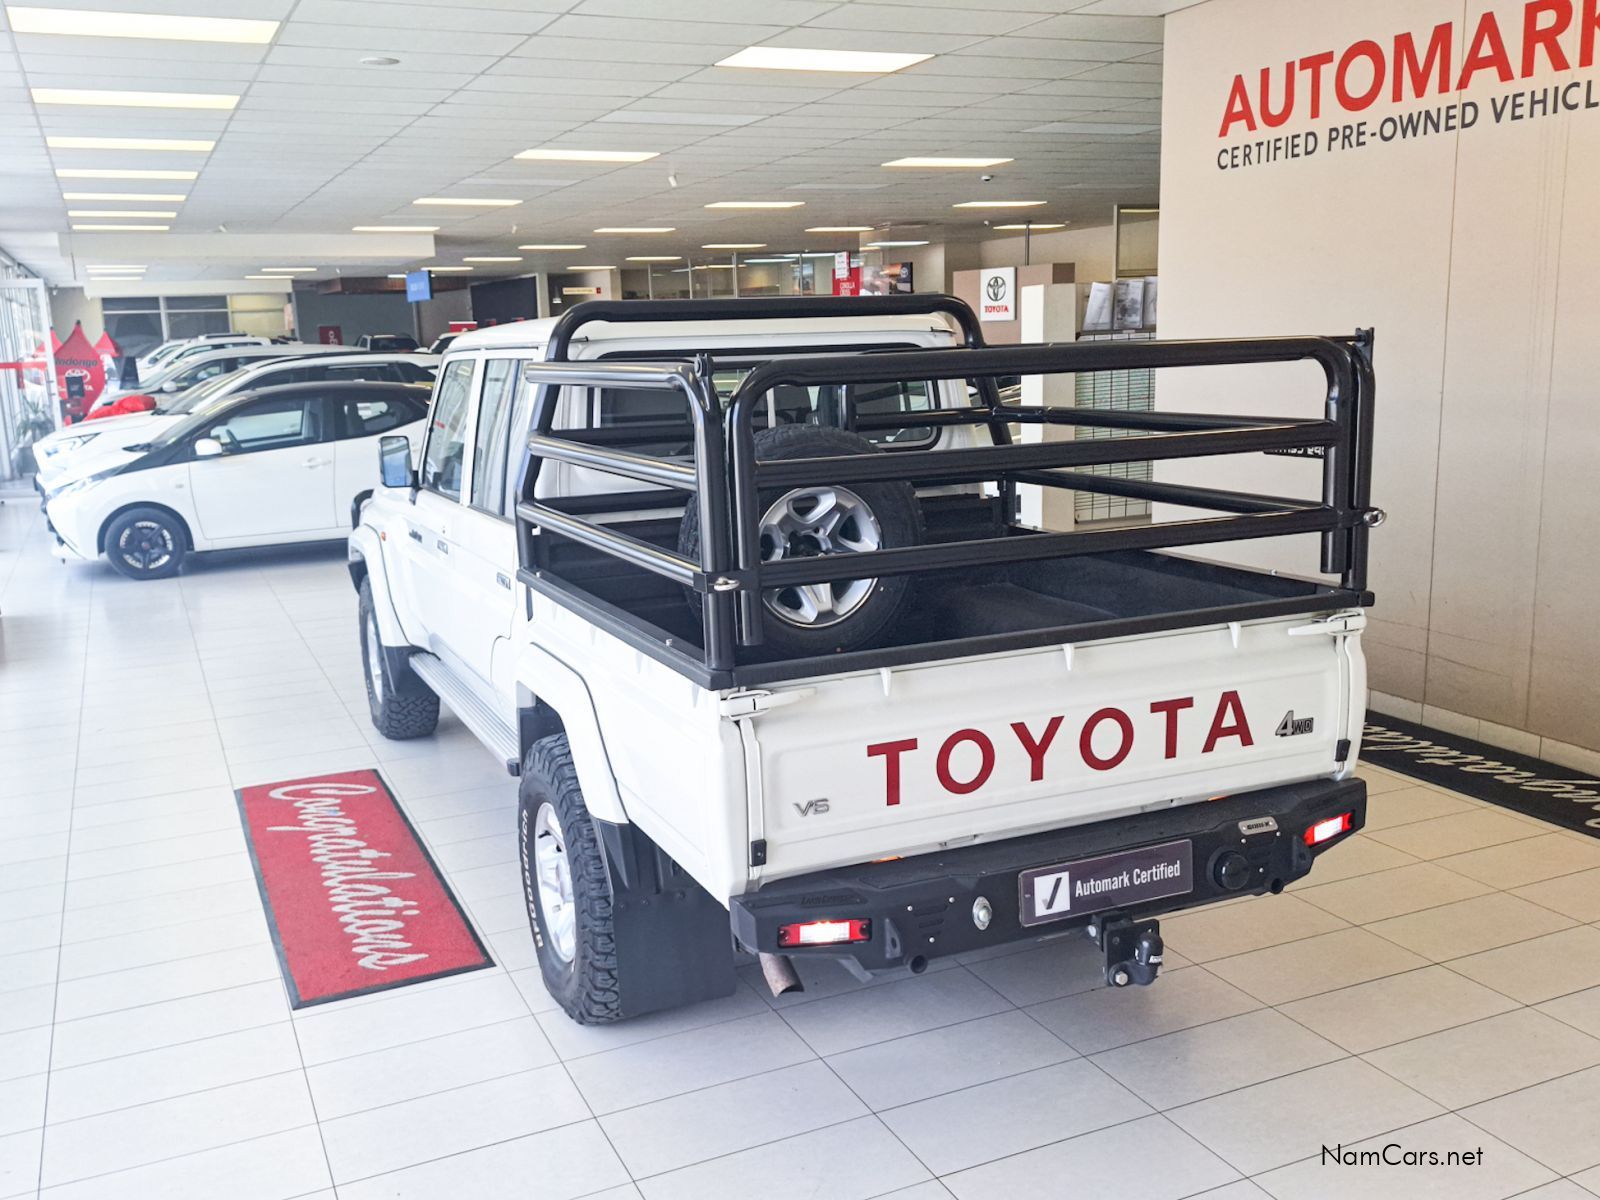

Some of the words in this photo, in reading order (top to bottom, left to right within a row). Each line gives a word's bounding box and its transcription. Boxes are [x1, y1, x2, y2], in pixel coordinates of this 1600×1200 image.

[1217, 133, 1318, 170] CERTIFIED
[1327, 101, 1479, 152] PRE-OWNED
[984, 305, 1009, 313] TOYOTA
[1275, 709, 1314, 737] 4WD
[866, 690, 1254, 807] TOYOTA
[792, 798, 830, 817] V6
[266, 783, 430, 971] Congratulations
[1075, 871, 1130, 898] Automark
[1133, 860, 1181, 886] Certified
